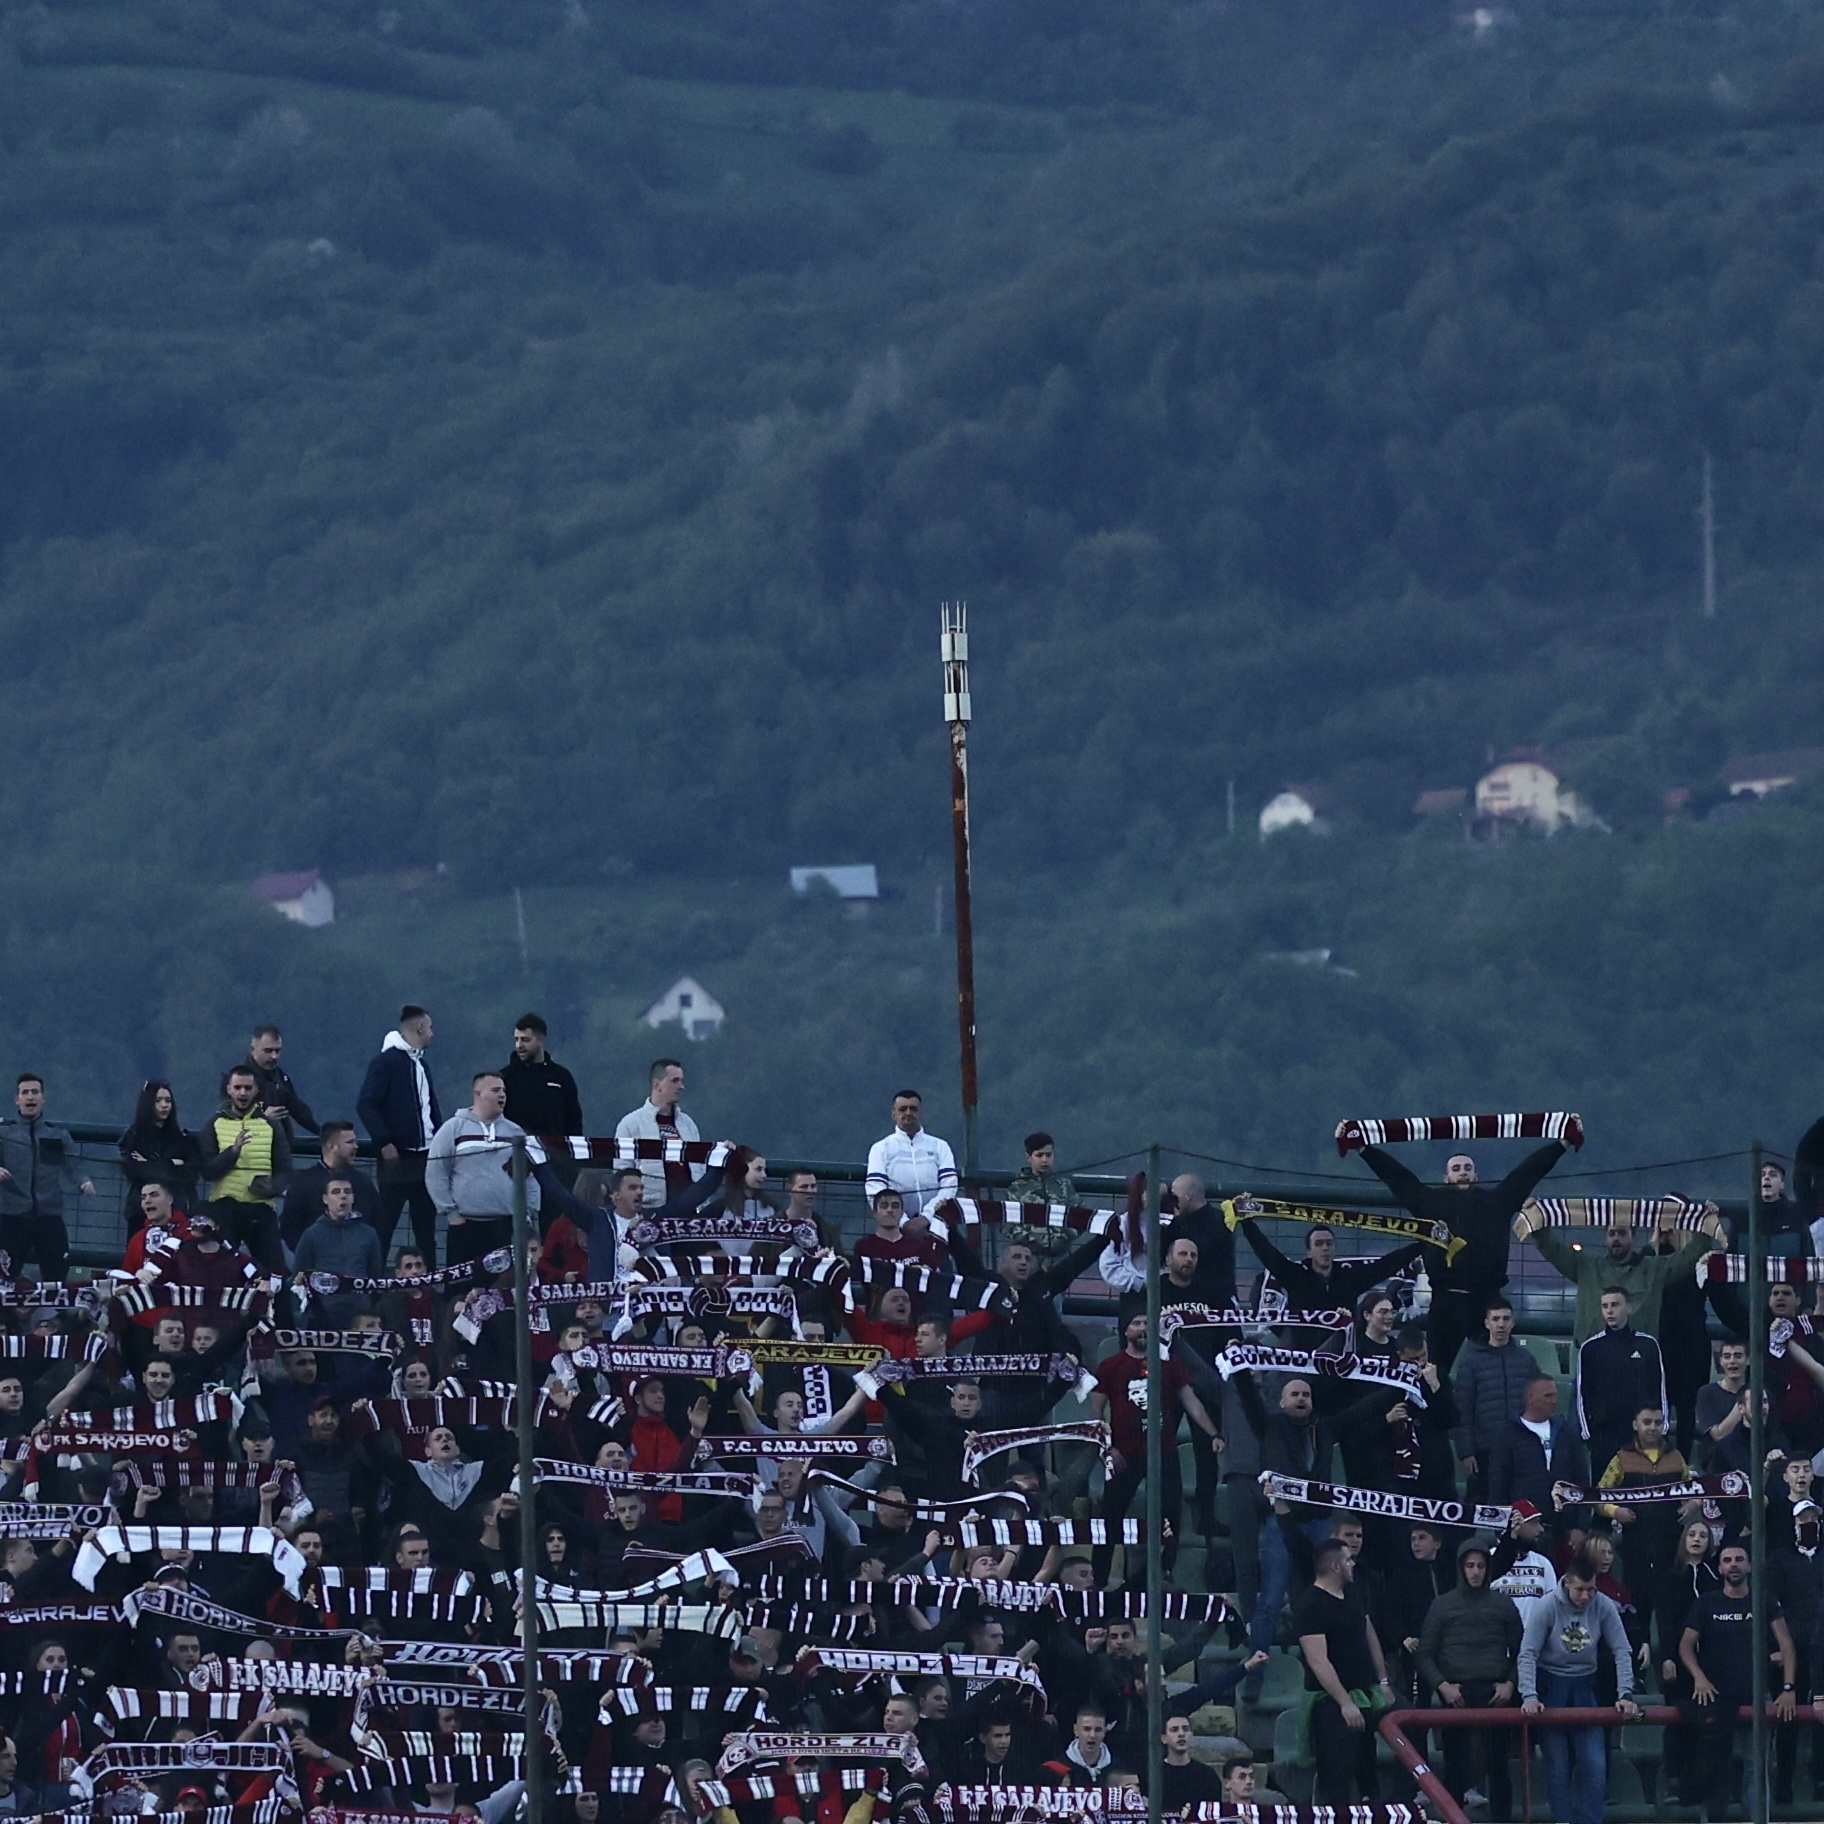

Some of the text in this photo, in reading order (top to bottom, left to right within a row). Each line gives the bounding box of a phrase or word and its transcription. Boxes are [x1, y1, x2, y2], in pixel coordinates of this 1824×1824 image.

[687, 1218, 793, 1236] SARAJEVO
[539, 1281, 629, 1300] SARAJEVO
[1204, 1307, 1341, 1325] SARAJEVO
[612, 1350, 688, 1369] SARAJEVO
[951, 1355, 1041, 1373] SARAJEVO
[76, 1431, 171, 1449] SARAJEVO
[759, 1439, 858, 1455] SARAJEVO
[553, 1462, 710, 1489] HORDE ZLA
[1669, 1478, 1704, 1496] ZLA
[1332, 1487, 1464, 1522] SARAJEVO
[171, 1597, 257, 1633] HORDE
[1712, 1613, 1742, 1621] NIKE
[756, 1735, 902, 1750] HORDE ZLA
[1000, 1785, 1104, 1811] SARAJEVO
